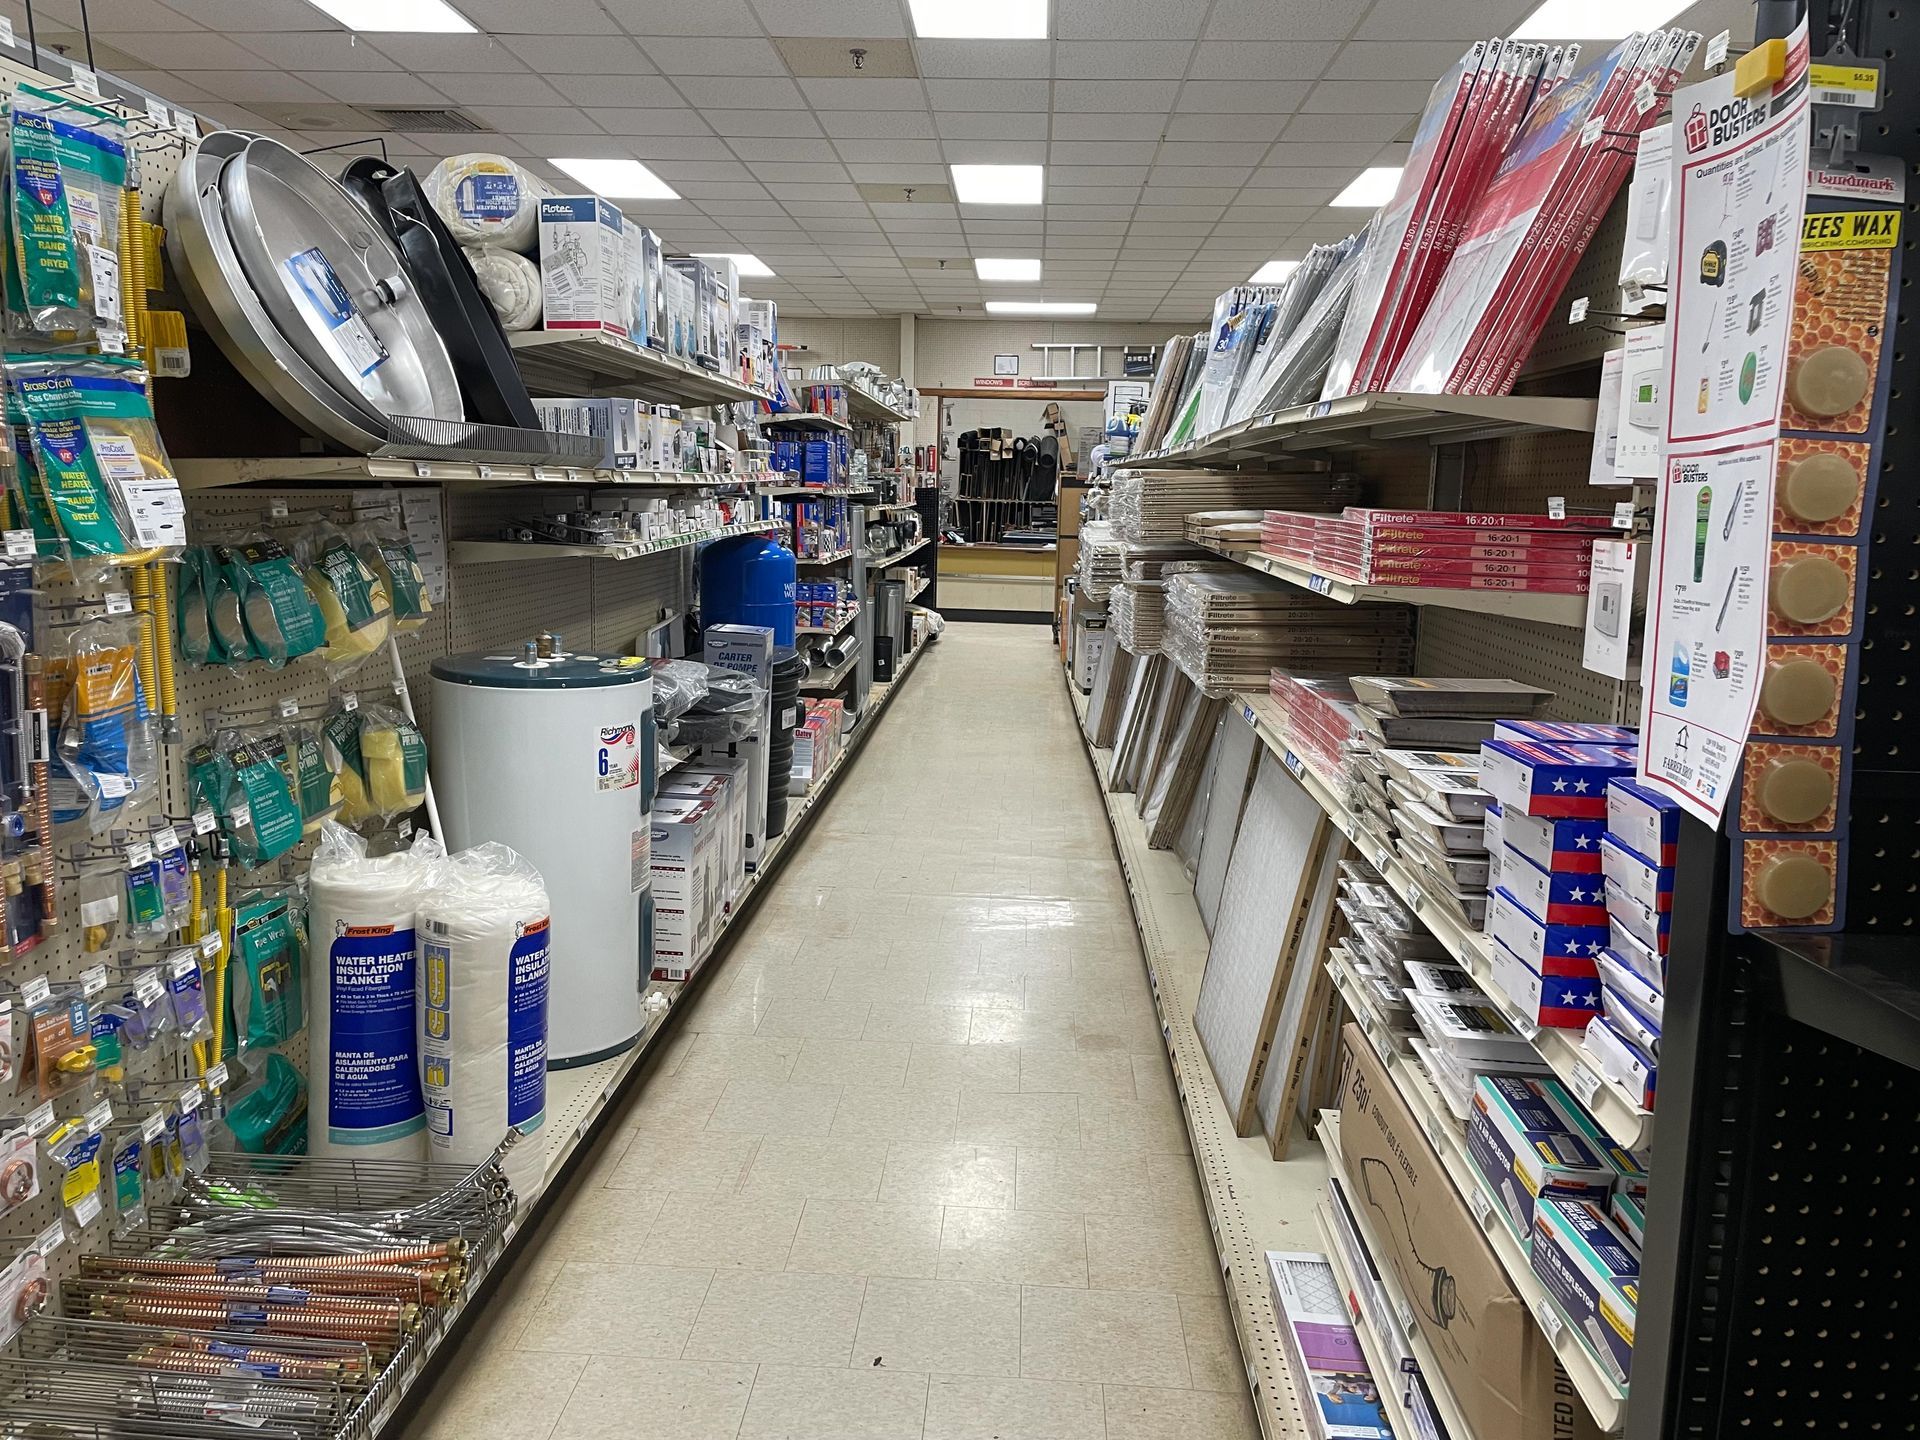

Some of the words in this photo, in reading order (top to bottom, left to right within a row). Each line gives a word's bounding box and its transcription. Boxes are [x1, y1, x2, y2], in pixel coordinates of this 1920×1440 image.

[1474, 44, 1484, 58] 3M
[1490, 41, 1500, 54] 3M
[1536, 46, 1545, 60] 3M
[1568, 47, 1578, 61] 3M
[1709, 98, 1748, 129] DOOR
[1713, 104, 1766, 146] BUSTERS
[1696, 160, 1733, 179] Quantities
[1817, 172, 1895, 191] Lundmark
[543, 204, 573, 212] Flotec
[33, 214, 63, 225] WATER
[1853, 214, 1895, 236] WAX
[33, 223, 65, 233] HEATER
[1560, 210, 1585, 248] 20x25x1
[1574, 216, 1600, 254] 20x25x1
[38, 241, 66, 252] RANGE
[40, 258, 69, 269] DRYER
[1445, 358, 1470, 394] Filtrete
[1463, 359, 1487, 395] Filtrete
[1481, 357, 1505, 395] Filtrete
[1497, 361, 1521, 396] Filtrete
[23, 377, 73, 391] BrassCraft
[28, 394, 43, 403] Gas
[61, 471, 86, 480] WATER
[1683, 472, 1708, 483] BUSTERS
[61, 480, 91, 489] HEATER
[67, 496, 95, 505] RANGE
[72, 512, 99, 521] DRYER
[1372, 513, 1414, 524] Filtrete
[1465, 516, 1505, 526] 16x20x1
[1382, 530, 1424, 540] Filtrete
[1487, 533, 1520, 542] 16x20x1
[1378, 544, 1420, 554] Filtrete
[1483, 548, 1515, 558] 16x20x1
[1380, 559, 1420, 570] Filtrete
[1484, 564, 1516, 573] 16x20x1
[1377, 573, 1420, 584] Filtrete
[1483, 578, 1515, 588] 16x20x1
[1210, 594, 1237, 602] Filtrete
[718, 652, 753, 662] CARTER
[726, 662, 758, 673] POMPE
[600, 724, 635, 736] Richmond
[795, 729, 812, 739] Oatey
[598, 748, 608, 776] 6
[336, 956, 375, 965] WATER
[515, 950, 544, 966] WATER
[336, 963, 403, 975] INSULATION
[336, 975, 390, 985] BLANKET
[515, 1044, 535, 1056] MANTA
[335, 1058, 387, 1066] AISLAMIENTO
[389, 1054, 408, 1062] PARA
[335, 1064, 396, 1072] CALENTADORES
[525, 1062, 539, 1074] AGUA
[1352, 1068, 1372, 1114] 25pi
[1371, 1104, 1389, 1138] CONDUIT
[1396, 1149, 1418, 1187] FLEXIBLE
[1487, 1135, 1511, 1172] DEFLECTOR
[1534, 1234, 1548, 1251] HEAT
[1551, 1254, 1562, 1273] AIR
[1561, 1265, 1595, 1312] DEFLECTOR
[1554, 1402, 1573, 1440] TED
